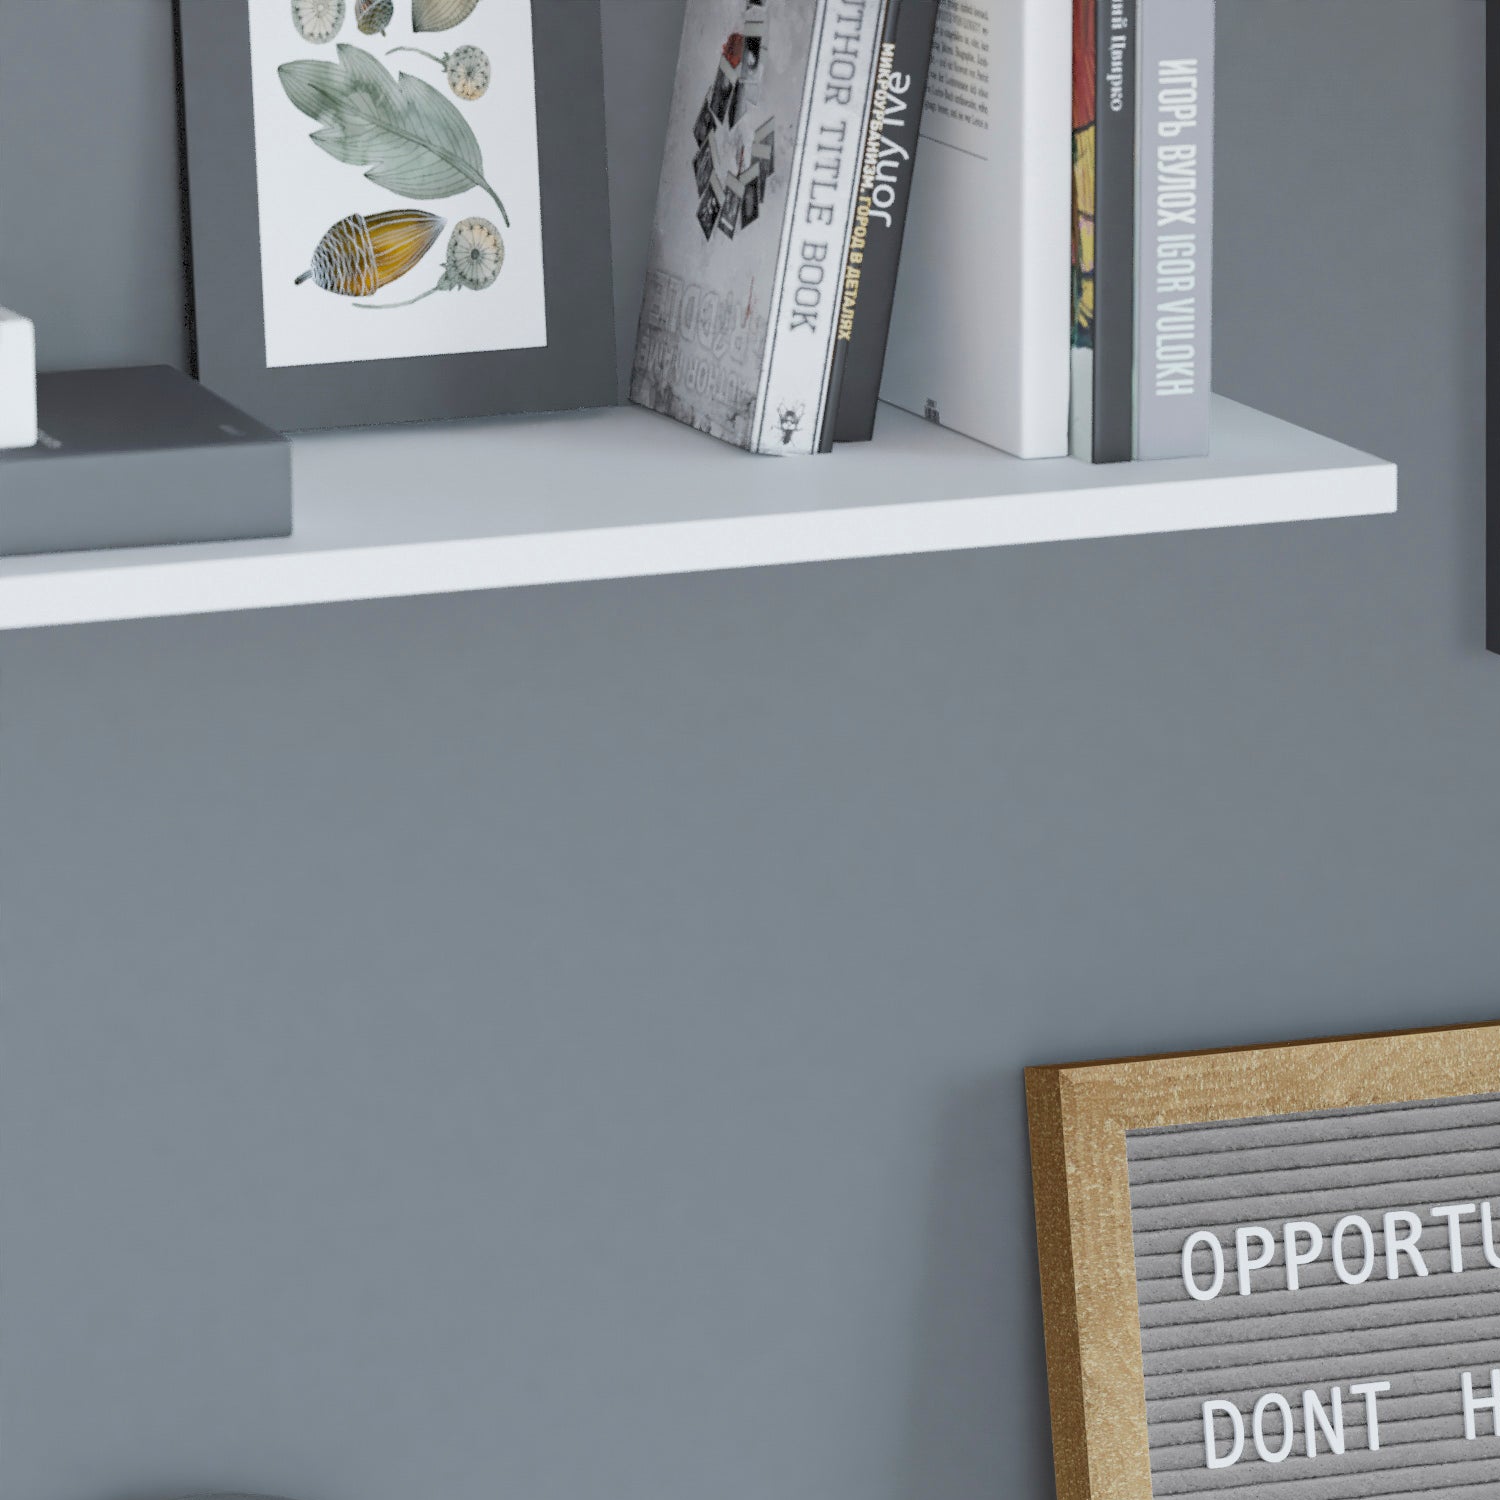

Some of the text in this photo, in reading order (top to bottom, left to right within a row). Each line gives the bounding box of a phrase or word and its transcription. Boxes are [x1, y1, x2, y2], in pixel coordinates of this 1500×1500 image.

[806, 121, 847, 226] TITLE
[867, 71, 911, 228] Jony Ive
[849, 196, 872, 249] ГОРОД
[850, 252, 864, 264] В
[1155, 58, 1198, 396] ИГОРЬ ВУЛОХ IGOR VULOKH
[790, 241, 828, 334] BOOK
[837, 265, 862, 341] ДЕТАЛЯХ
[1202, 1381, 1391, 1470] DONT
